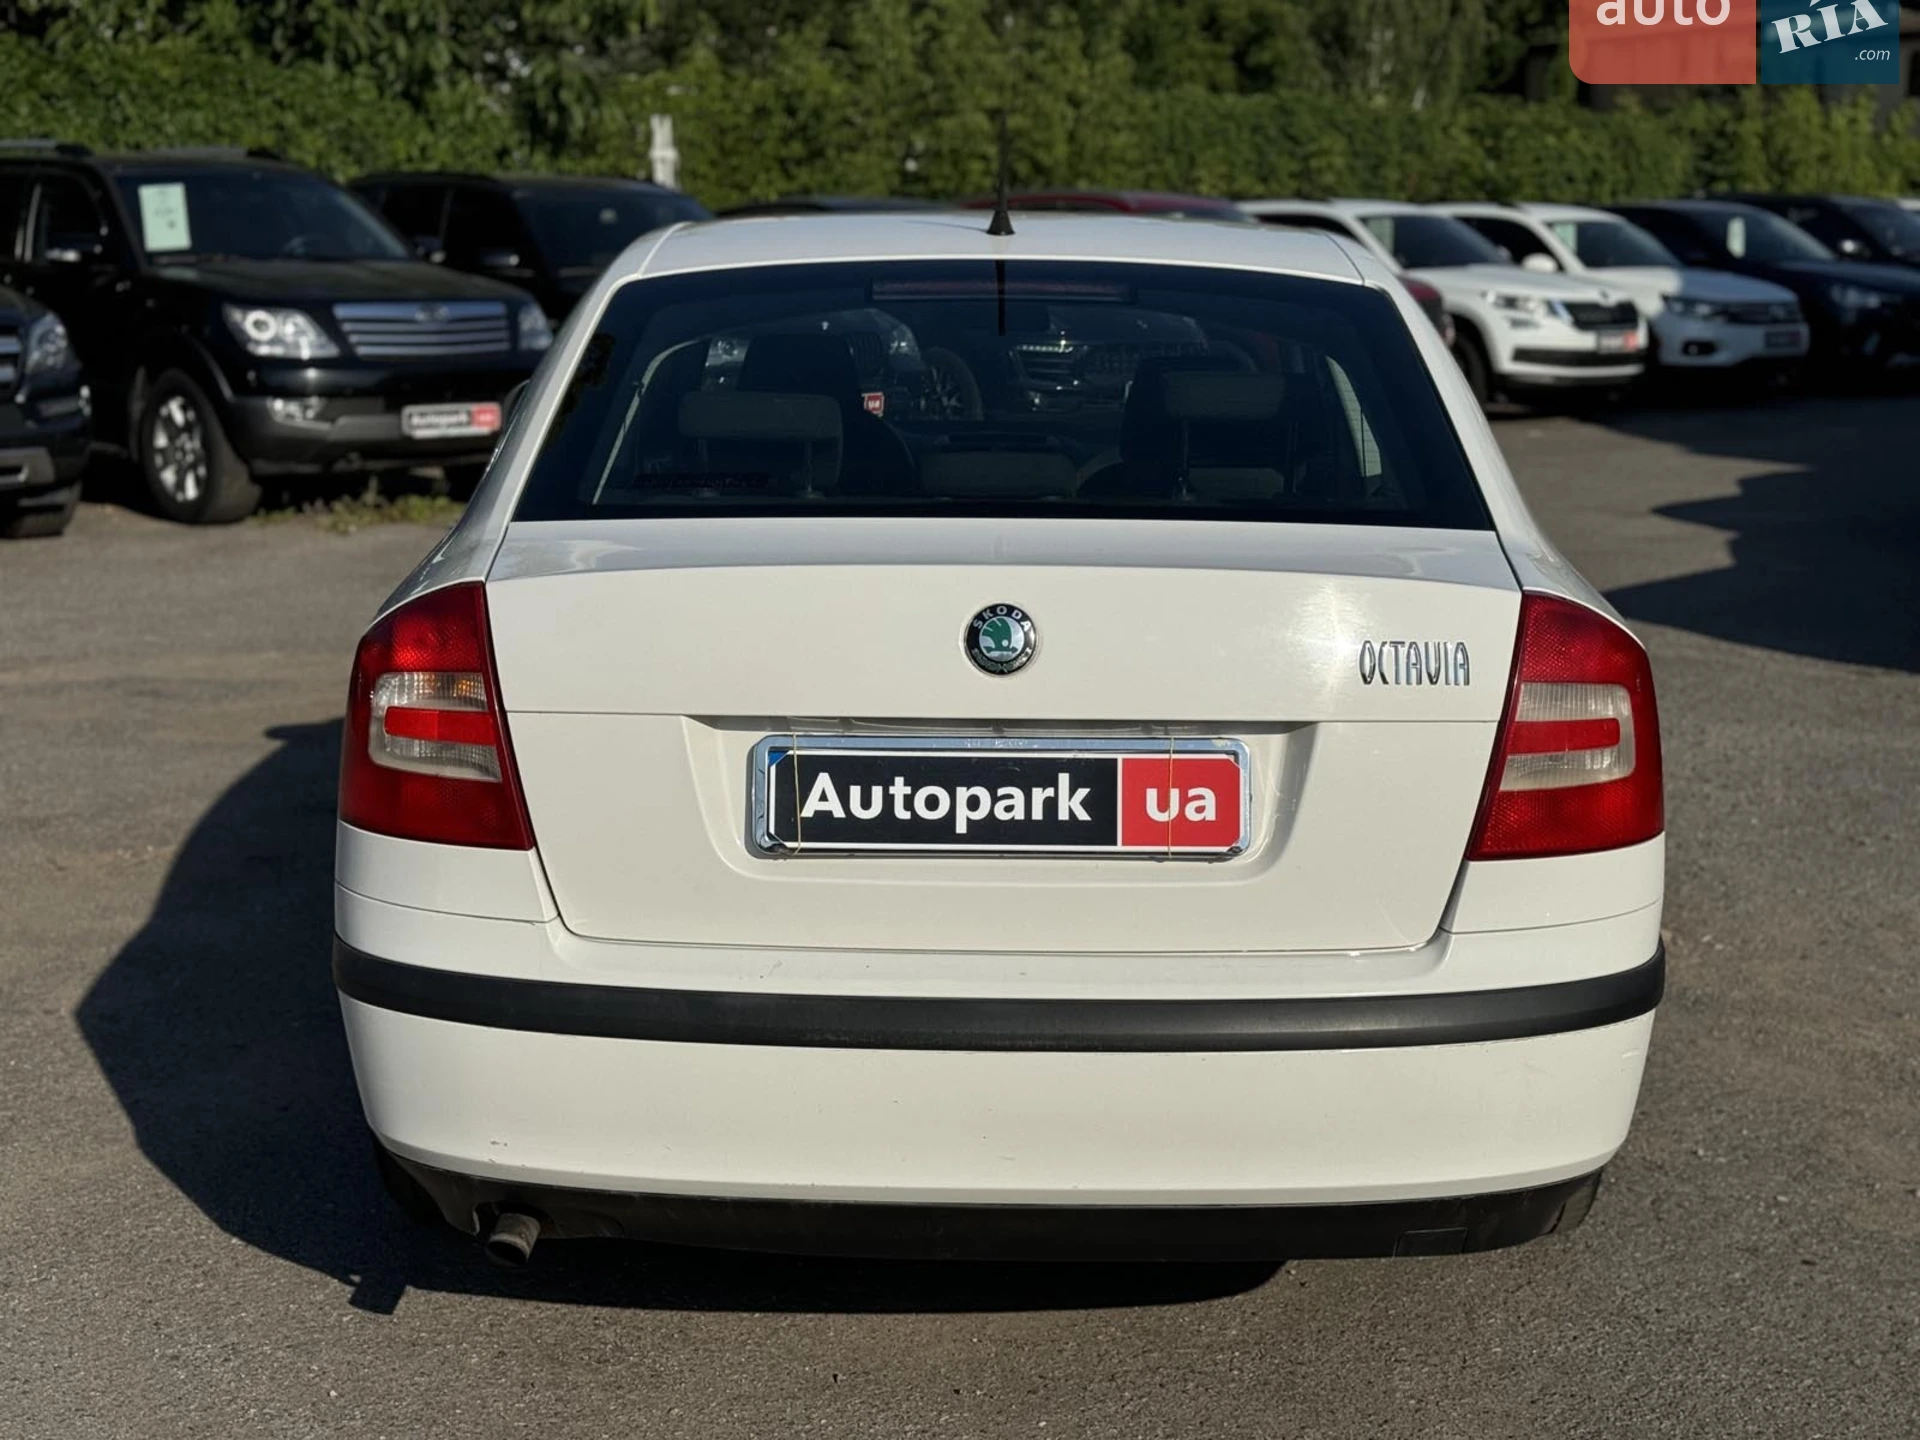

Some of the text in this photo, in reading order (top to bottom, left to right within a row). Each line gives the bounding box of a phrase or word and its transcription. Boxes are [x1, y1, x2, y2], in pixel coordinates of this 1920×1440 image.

[972, 605, 1032, 632] SKODA
[1359, 640, 1470, 686] OCTAVIA
[800, 771, 1217, 834] Autopark ua
